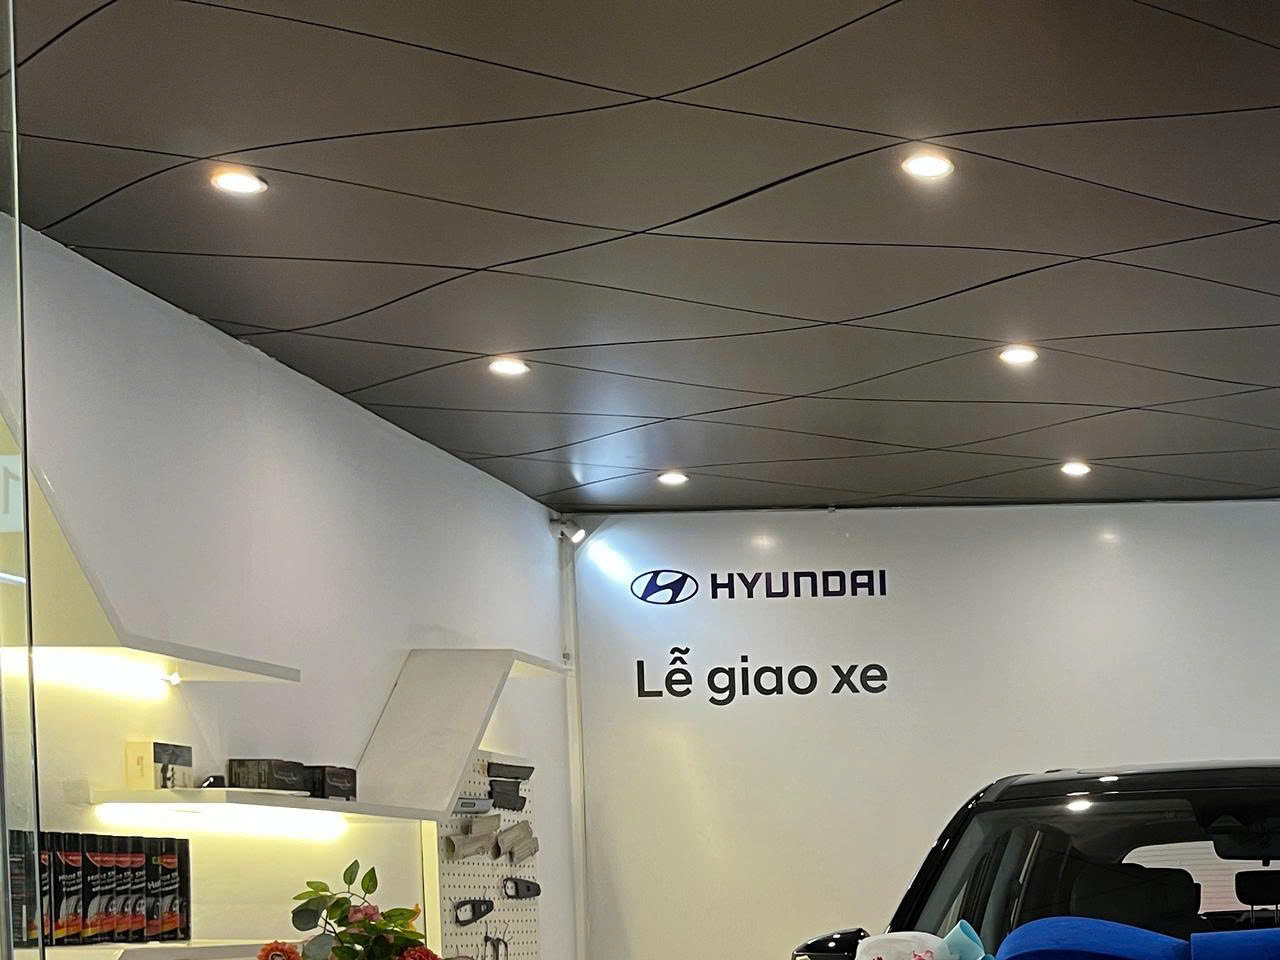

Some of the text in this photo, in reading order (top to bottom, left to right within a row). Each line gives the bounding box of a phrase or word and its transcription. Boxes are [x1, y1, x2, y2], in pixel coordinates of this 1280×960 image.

[710, 569, 887, 600] HYUNDAI
[636, 647, 888, 706] Lễ giao xe
